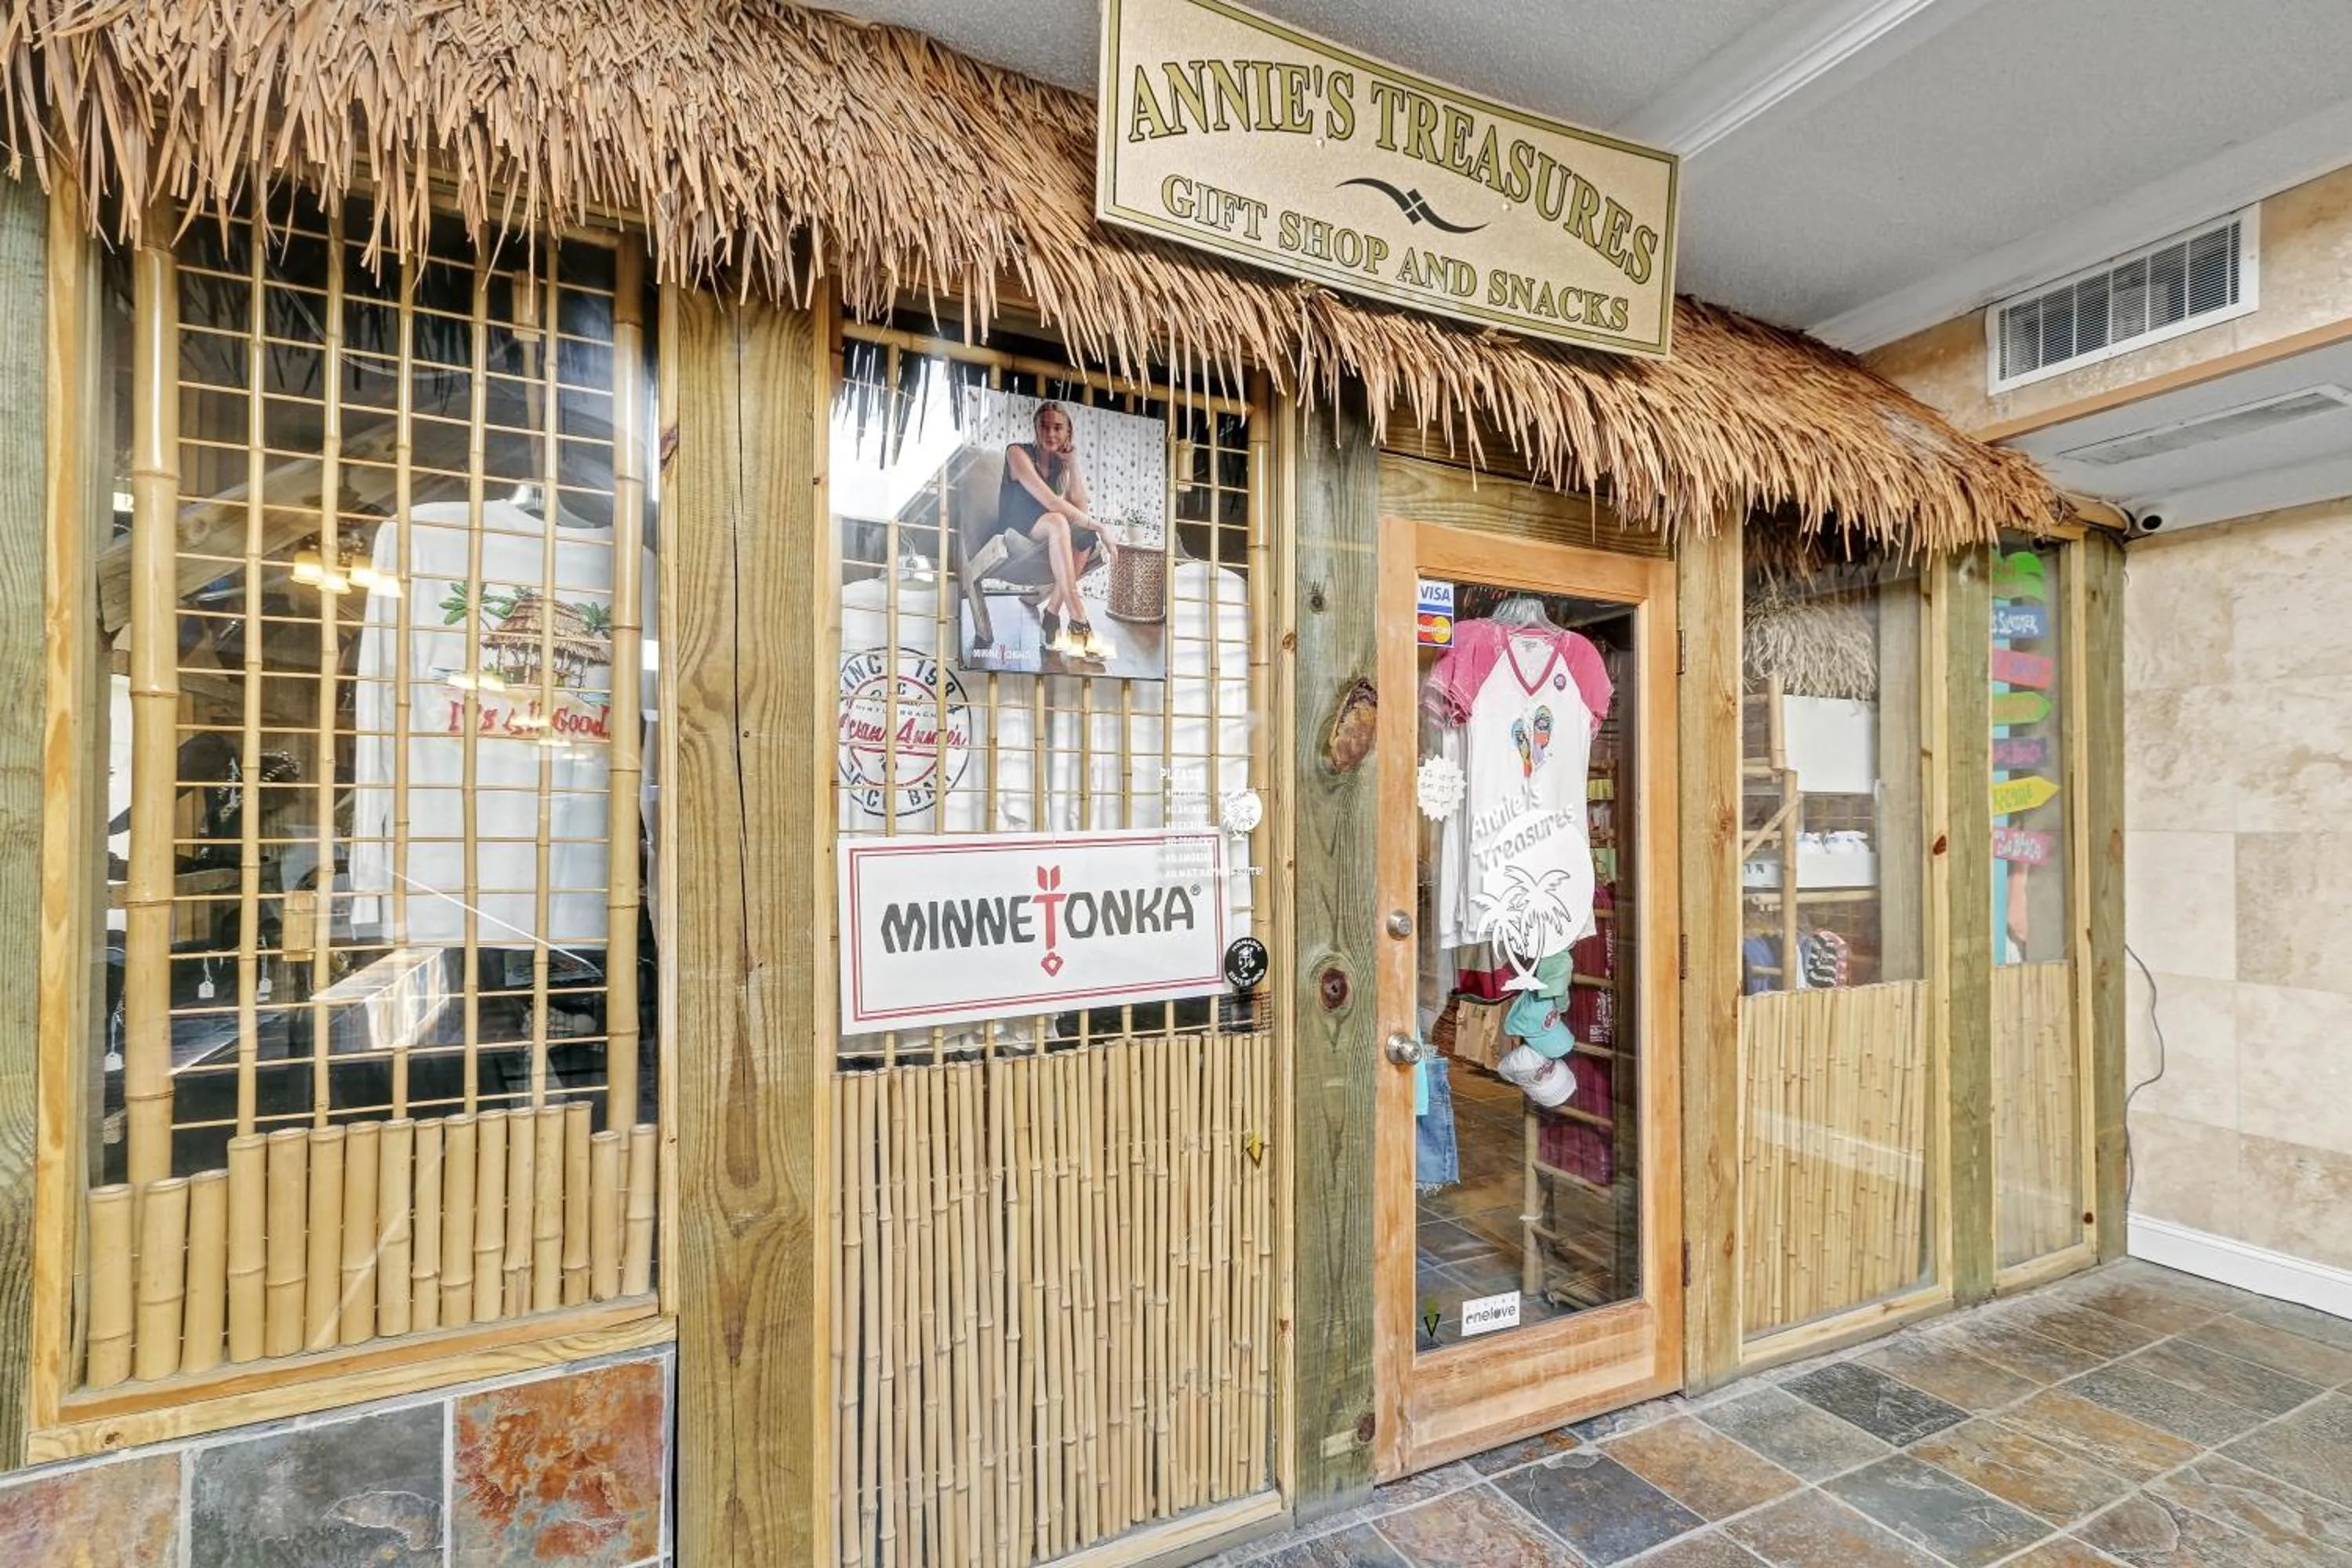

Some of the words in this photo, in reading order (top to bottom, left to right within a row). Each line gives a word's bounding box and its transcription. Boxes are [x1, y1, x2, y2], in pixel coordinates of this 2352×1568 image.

[1129, 60, 1354, 142] ANNIE'S
[1371, 81, 1658, 285] TREASURES
[1161, 173, 1268, 241] GIFT
[1278, 211, 1388, 275] SHOP
[1396, 247, 1477, 299] AND
[1487, 268, 1628, 332] SNACKS
[1421, 586, 1450, 602] VISA
[880, 885, 1195, 954] MINNETONKA
